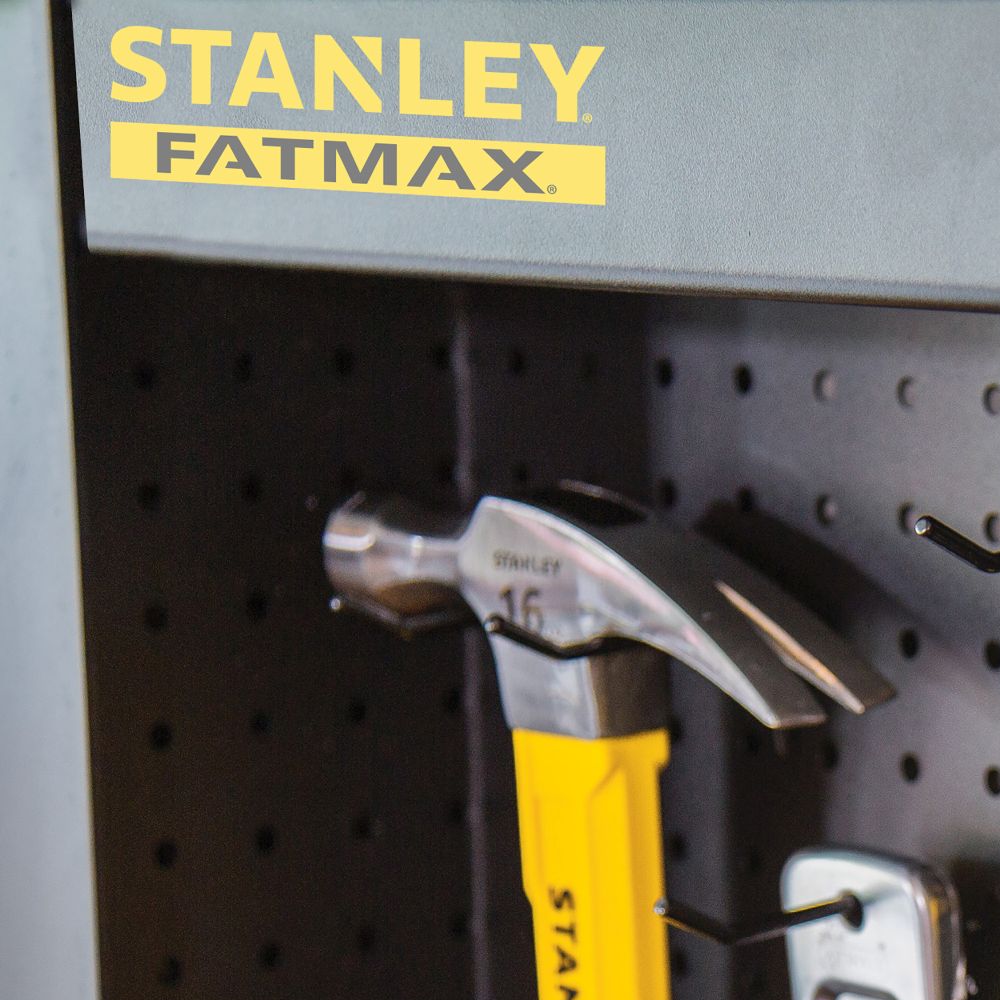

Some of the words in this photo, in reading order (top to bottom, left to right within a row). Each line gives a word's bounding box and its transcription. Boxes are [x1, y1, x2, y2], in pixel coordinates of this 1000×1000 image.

[109, 25, 605, 123] STANLEY
[156, 131, 547, 194] FATMAX
[493, 550, 562, 575] STANLEY
